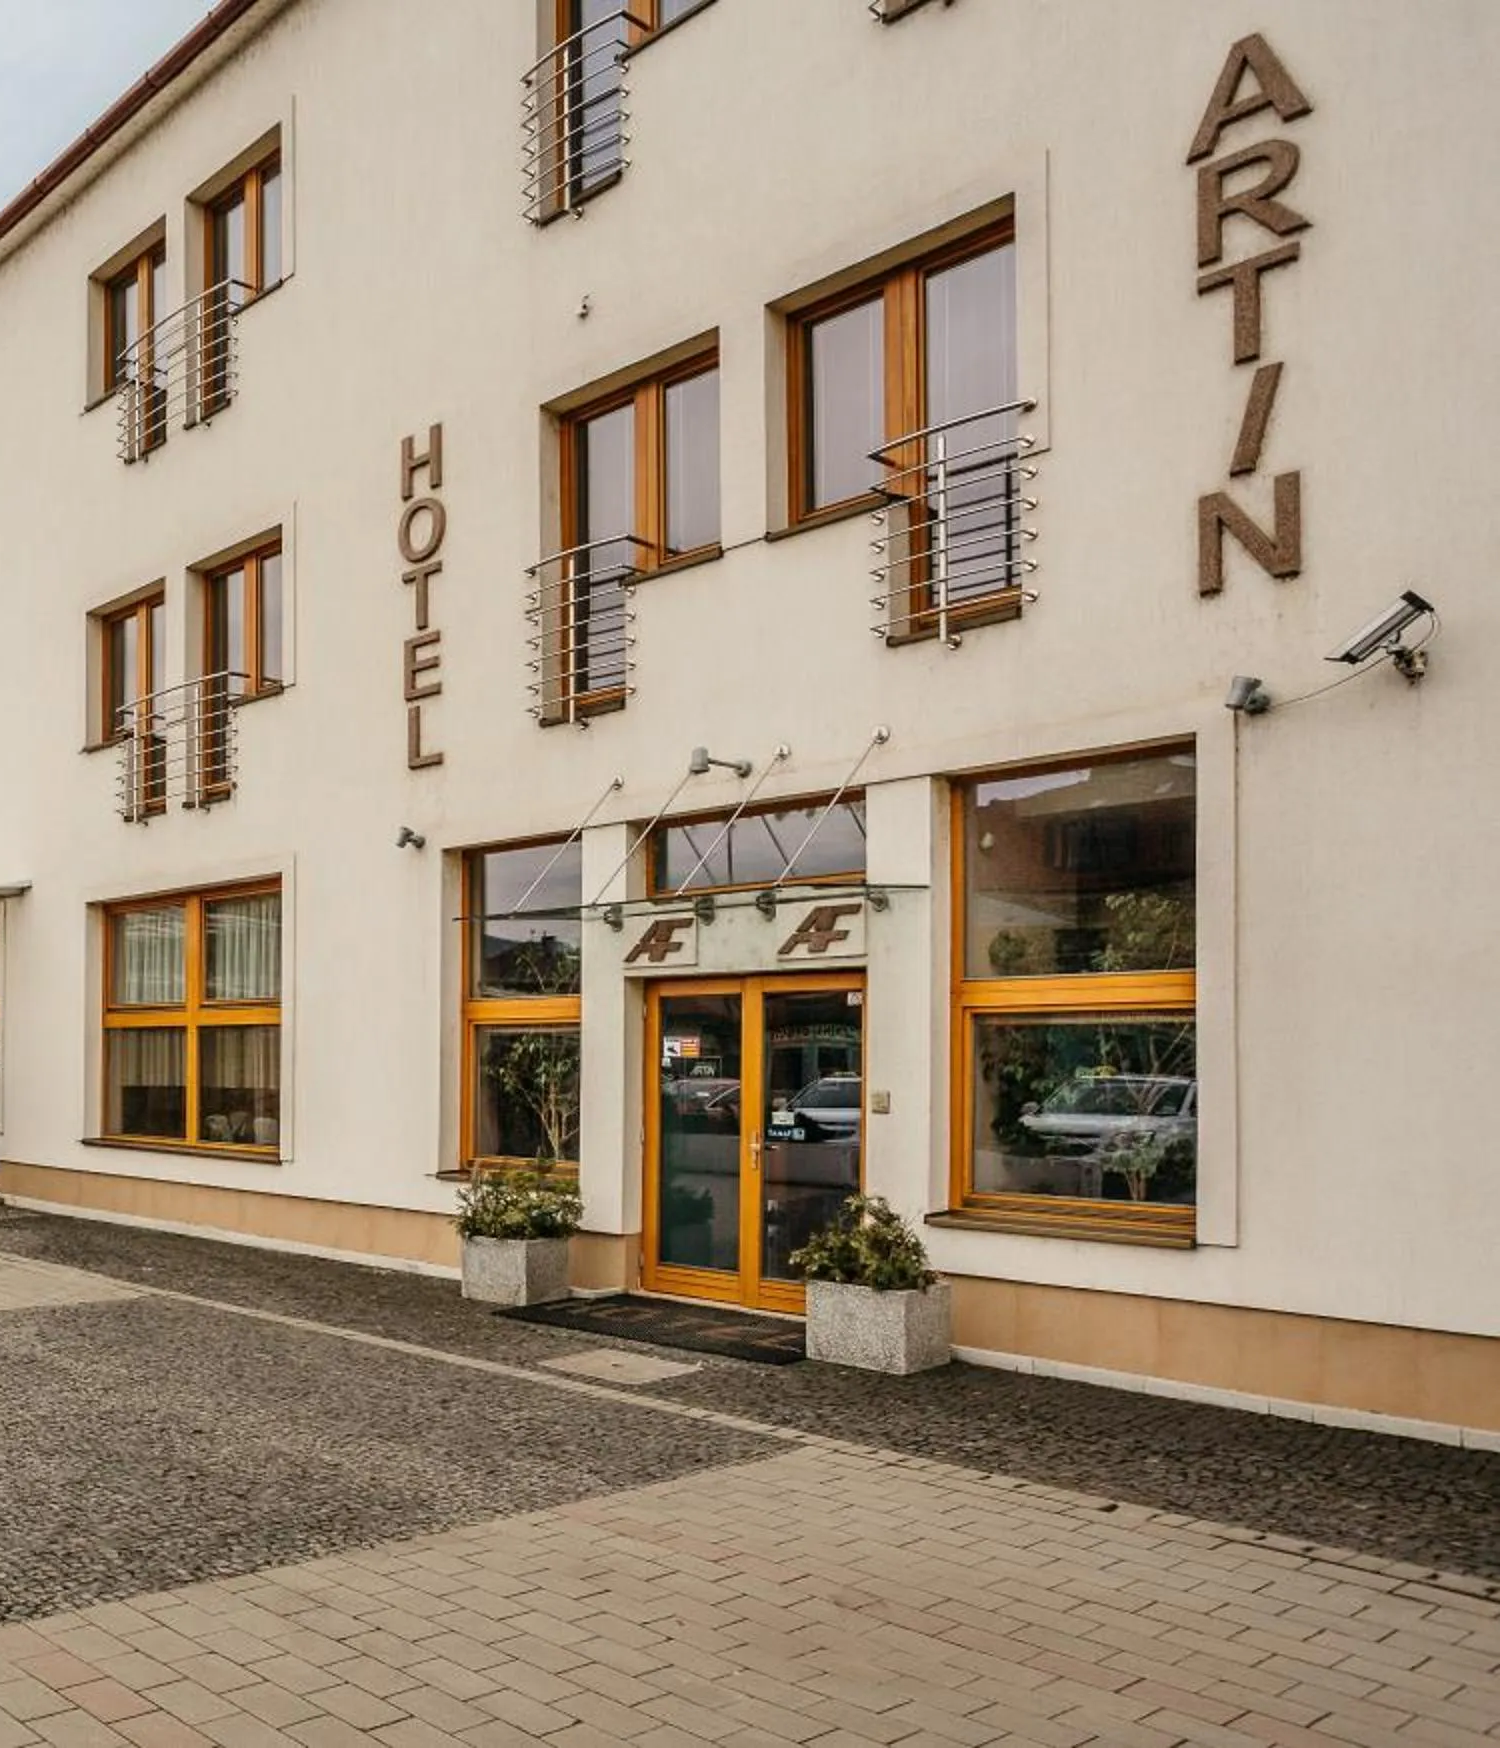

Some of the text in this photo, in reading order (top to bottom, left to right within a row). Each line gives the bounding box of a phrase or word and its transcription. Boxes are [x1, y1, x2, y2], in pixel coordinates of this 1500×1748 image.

[1186, 32, 1314, 599] ARTIN
[398, 422, 447, 770] HOTEL
[623, 918, 695, 963] AF
[777, 903, 863, 955] AF
